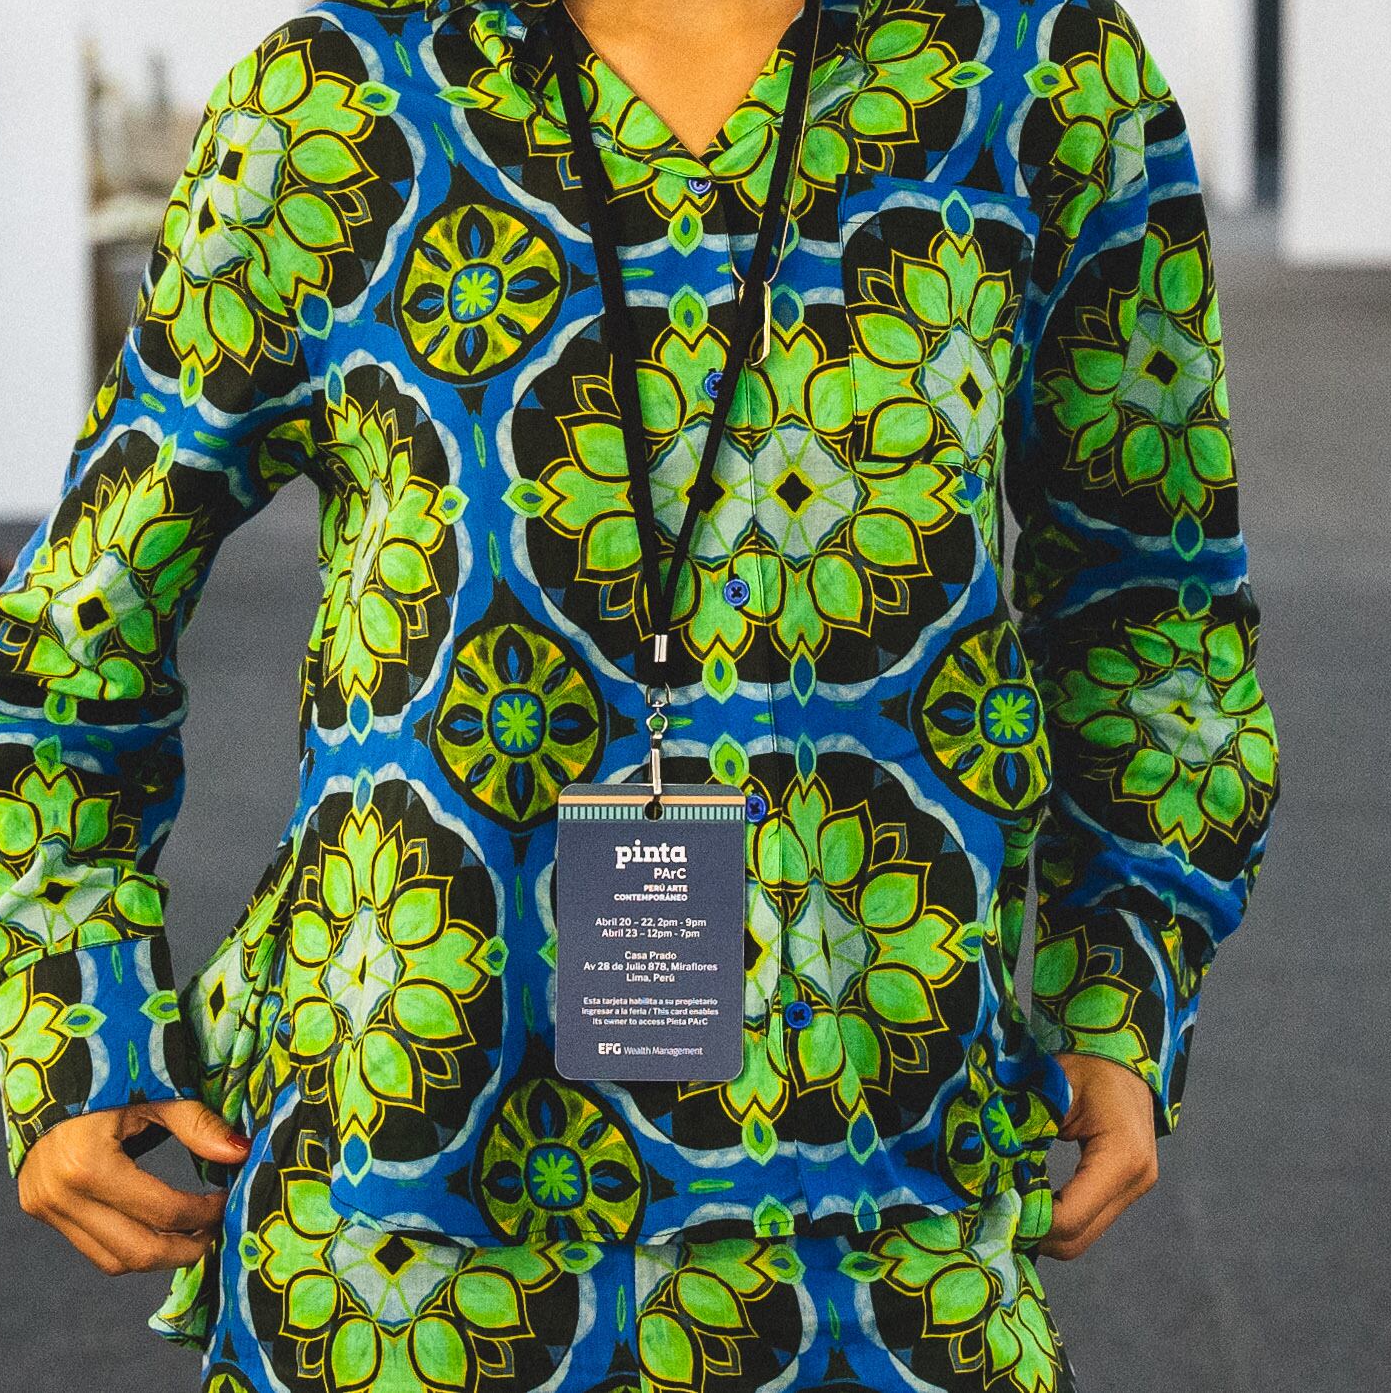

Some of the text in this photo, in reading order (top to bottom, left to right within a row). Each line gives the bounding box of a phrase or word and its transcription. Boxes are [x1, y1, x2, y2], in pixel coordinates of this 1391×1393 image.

[615, 839, 687, 869] pinta
[654, 867, 687, 879] PArC
[643, 883, 688, 892] PERÚ ARTE
[614, 893, 687, 901] CONTEMPORÁNEO
[595, 917, 617, 926] Abril
[618, 917, 632, 926] 20
[657, 917, 678, 927] 2pm
[685, 917, 707, 927] 9pm
[601, 928, 624, 937] Abril
[625, 928, 638, 938] 23
[647, 928, 672, 939] 12pm
[680, 928, 700, 939] 7pm
[624, 951, 677, 960] Casa Prado
[583, 962, 596, 970] Av
[597, 962, 610, 970] 28
[611, 962, 624, 970] de
[625, 962, 647, 970] Julio
[671, 962, 718, 971] Miraflores
[653, 973, 675, 982] Perú
[602, 997, 628, 1005] tarjeta
[653, 1007, 669, 1015] This
[666, 1017, 687, 1025] Pinta
[687, 1017, 708, 1025] PArC
[598, 1043, 703, 1057] EFG Wealth Management
